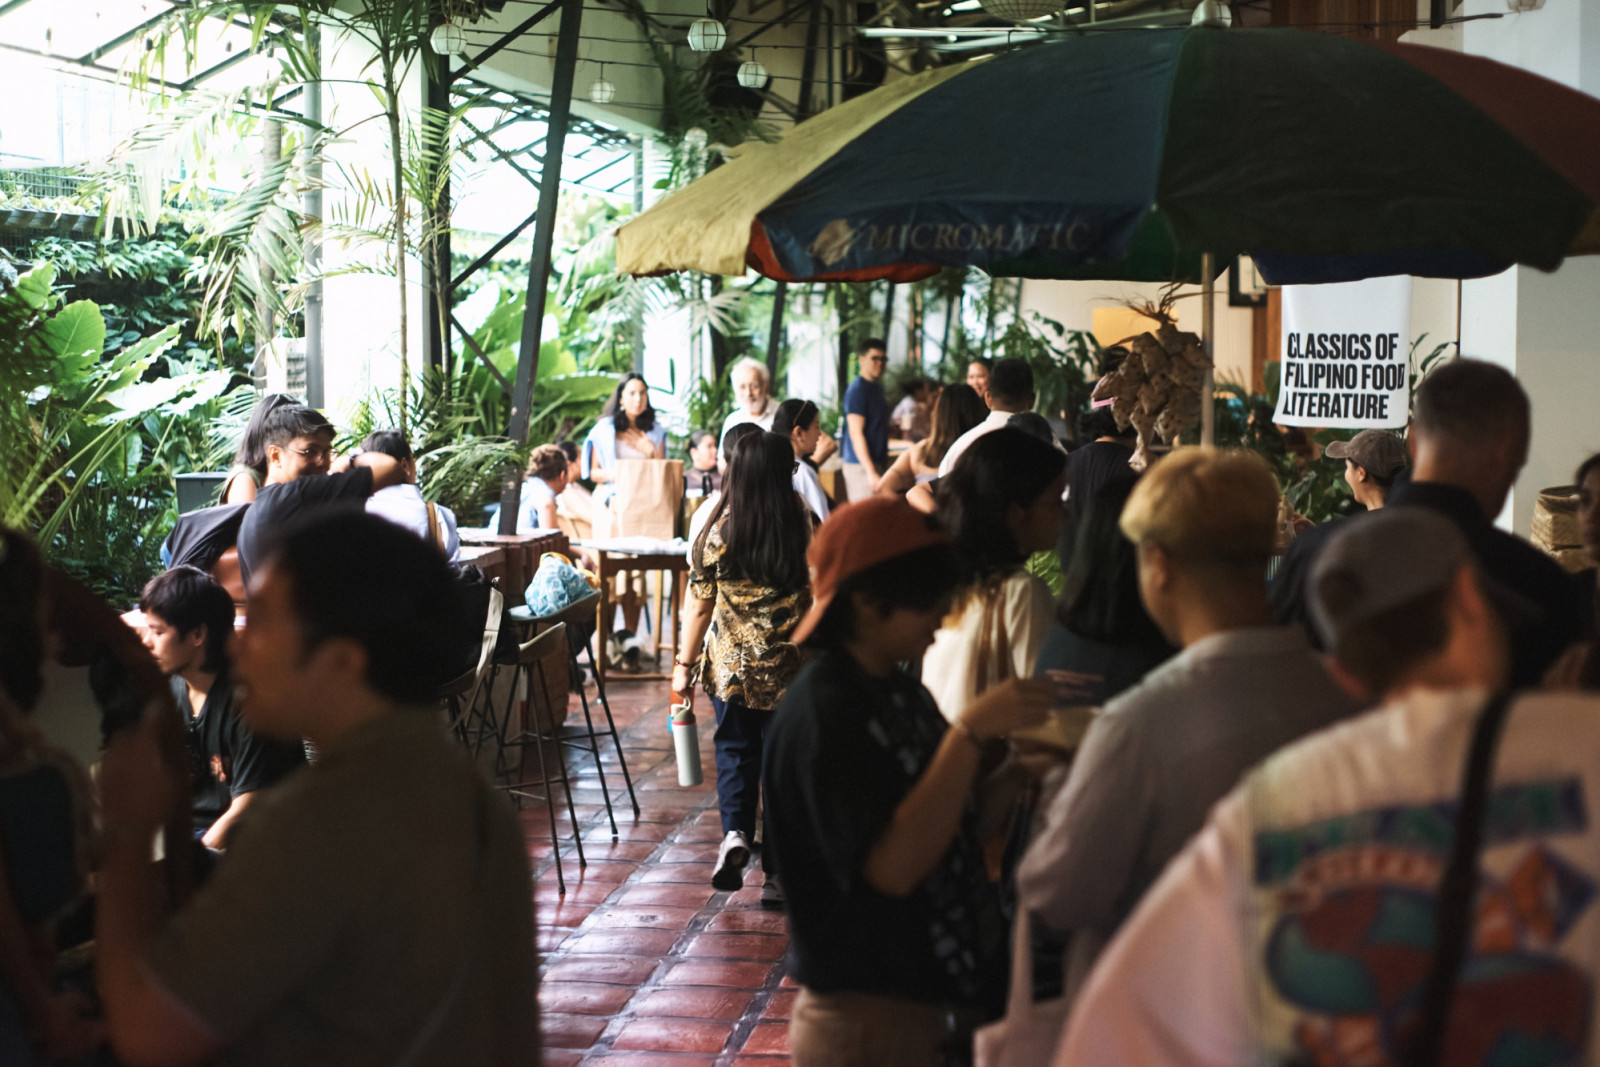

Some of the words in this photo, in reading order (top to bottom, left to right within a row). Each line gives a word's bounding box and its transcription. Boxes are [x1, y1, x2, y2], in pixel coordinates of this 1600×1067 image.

[867, 222, 1089, 250] MICROMATIC
[1287, 332, 1372, 360] CLASSICS
[1375, 333, 1399, 360] OF
[1284, 361, 1358, 389] FILIPINO
[1361, 363, 1405, 391] FOOD
[1282, 391, 1389, 419] LITERATURE
